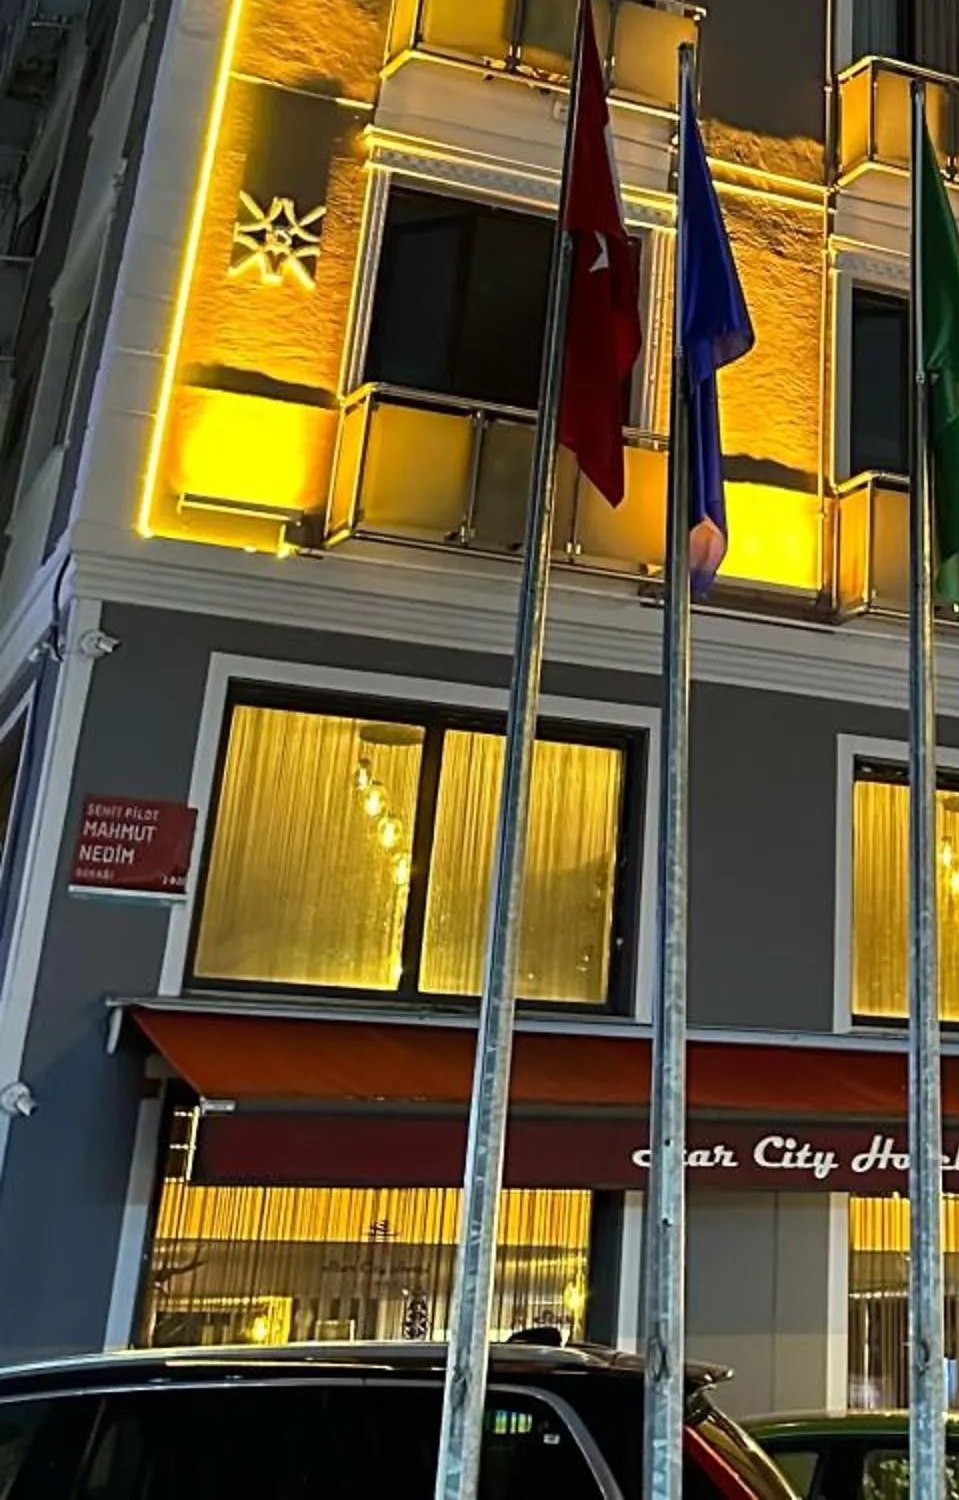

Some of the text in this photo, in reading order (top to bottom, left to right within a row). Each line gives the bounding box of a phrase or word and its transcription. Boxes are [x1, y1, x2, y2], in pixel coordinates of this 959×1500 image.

[83, 820, 156, 843] MAHMUT
[79, 844, 135, 864] NEDİM
[753, 1135, 839, 1179] City
